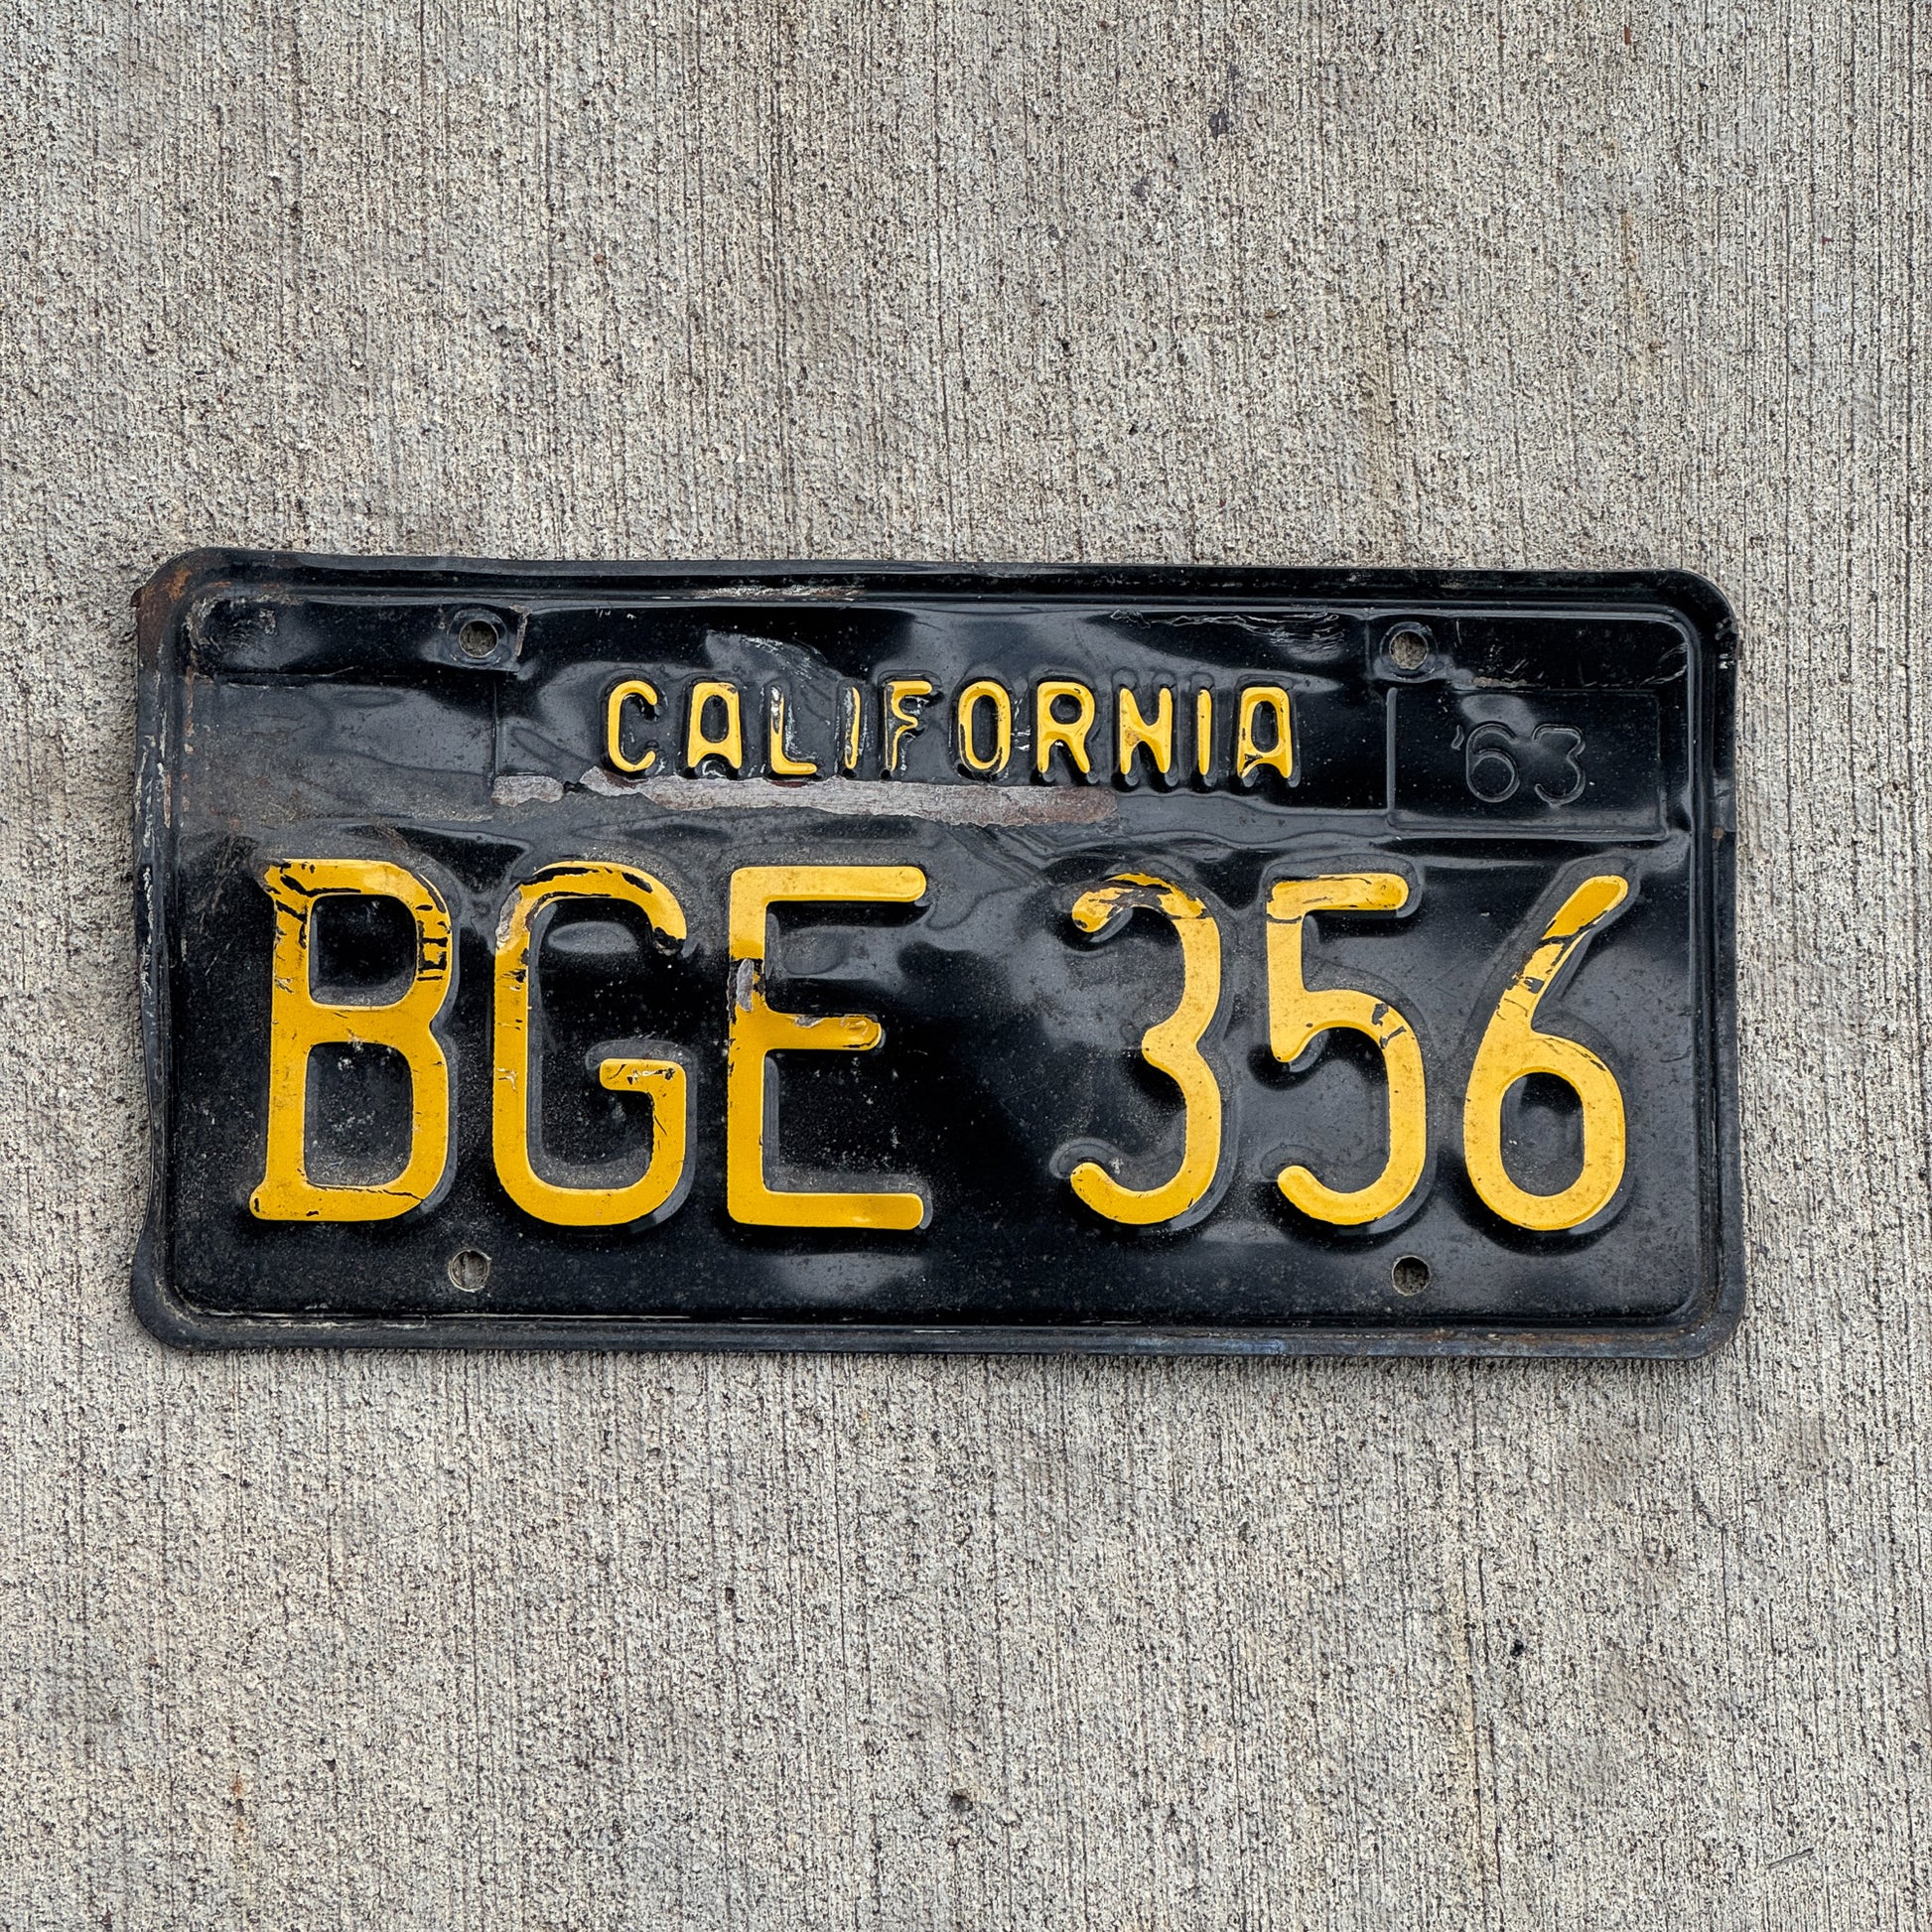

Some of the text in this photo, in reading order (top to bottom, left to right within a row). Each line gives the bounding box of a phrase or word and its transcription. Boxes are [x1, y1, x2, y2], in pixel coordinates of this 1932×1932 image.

[605, 679, 1294, 779] CALIFORNIA
[250, 858, 1630, 1232] BGE 356
